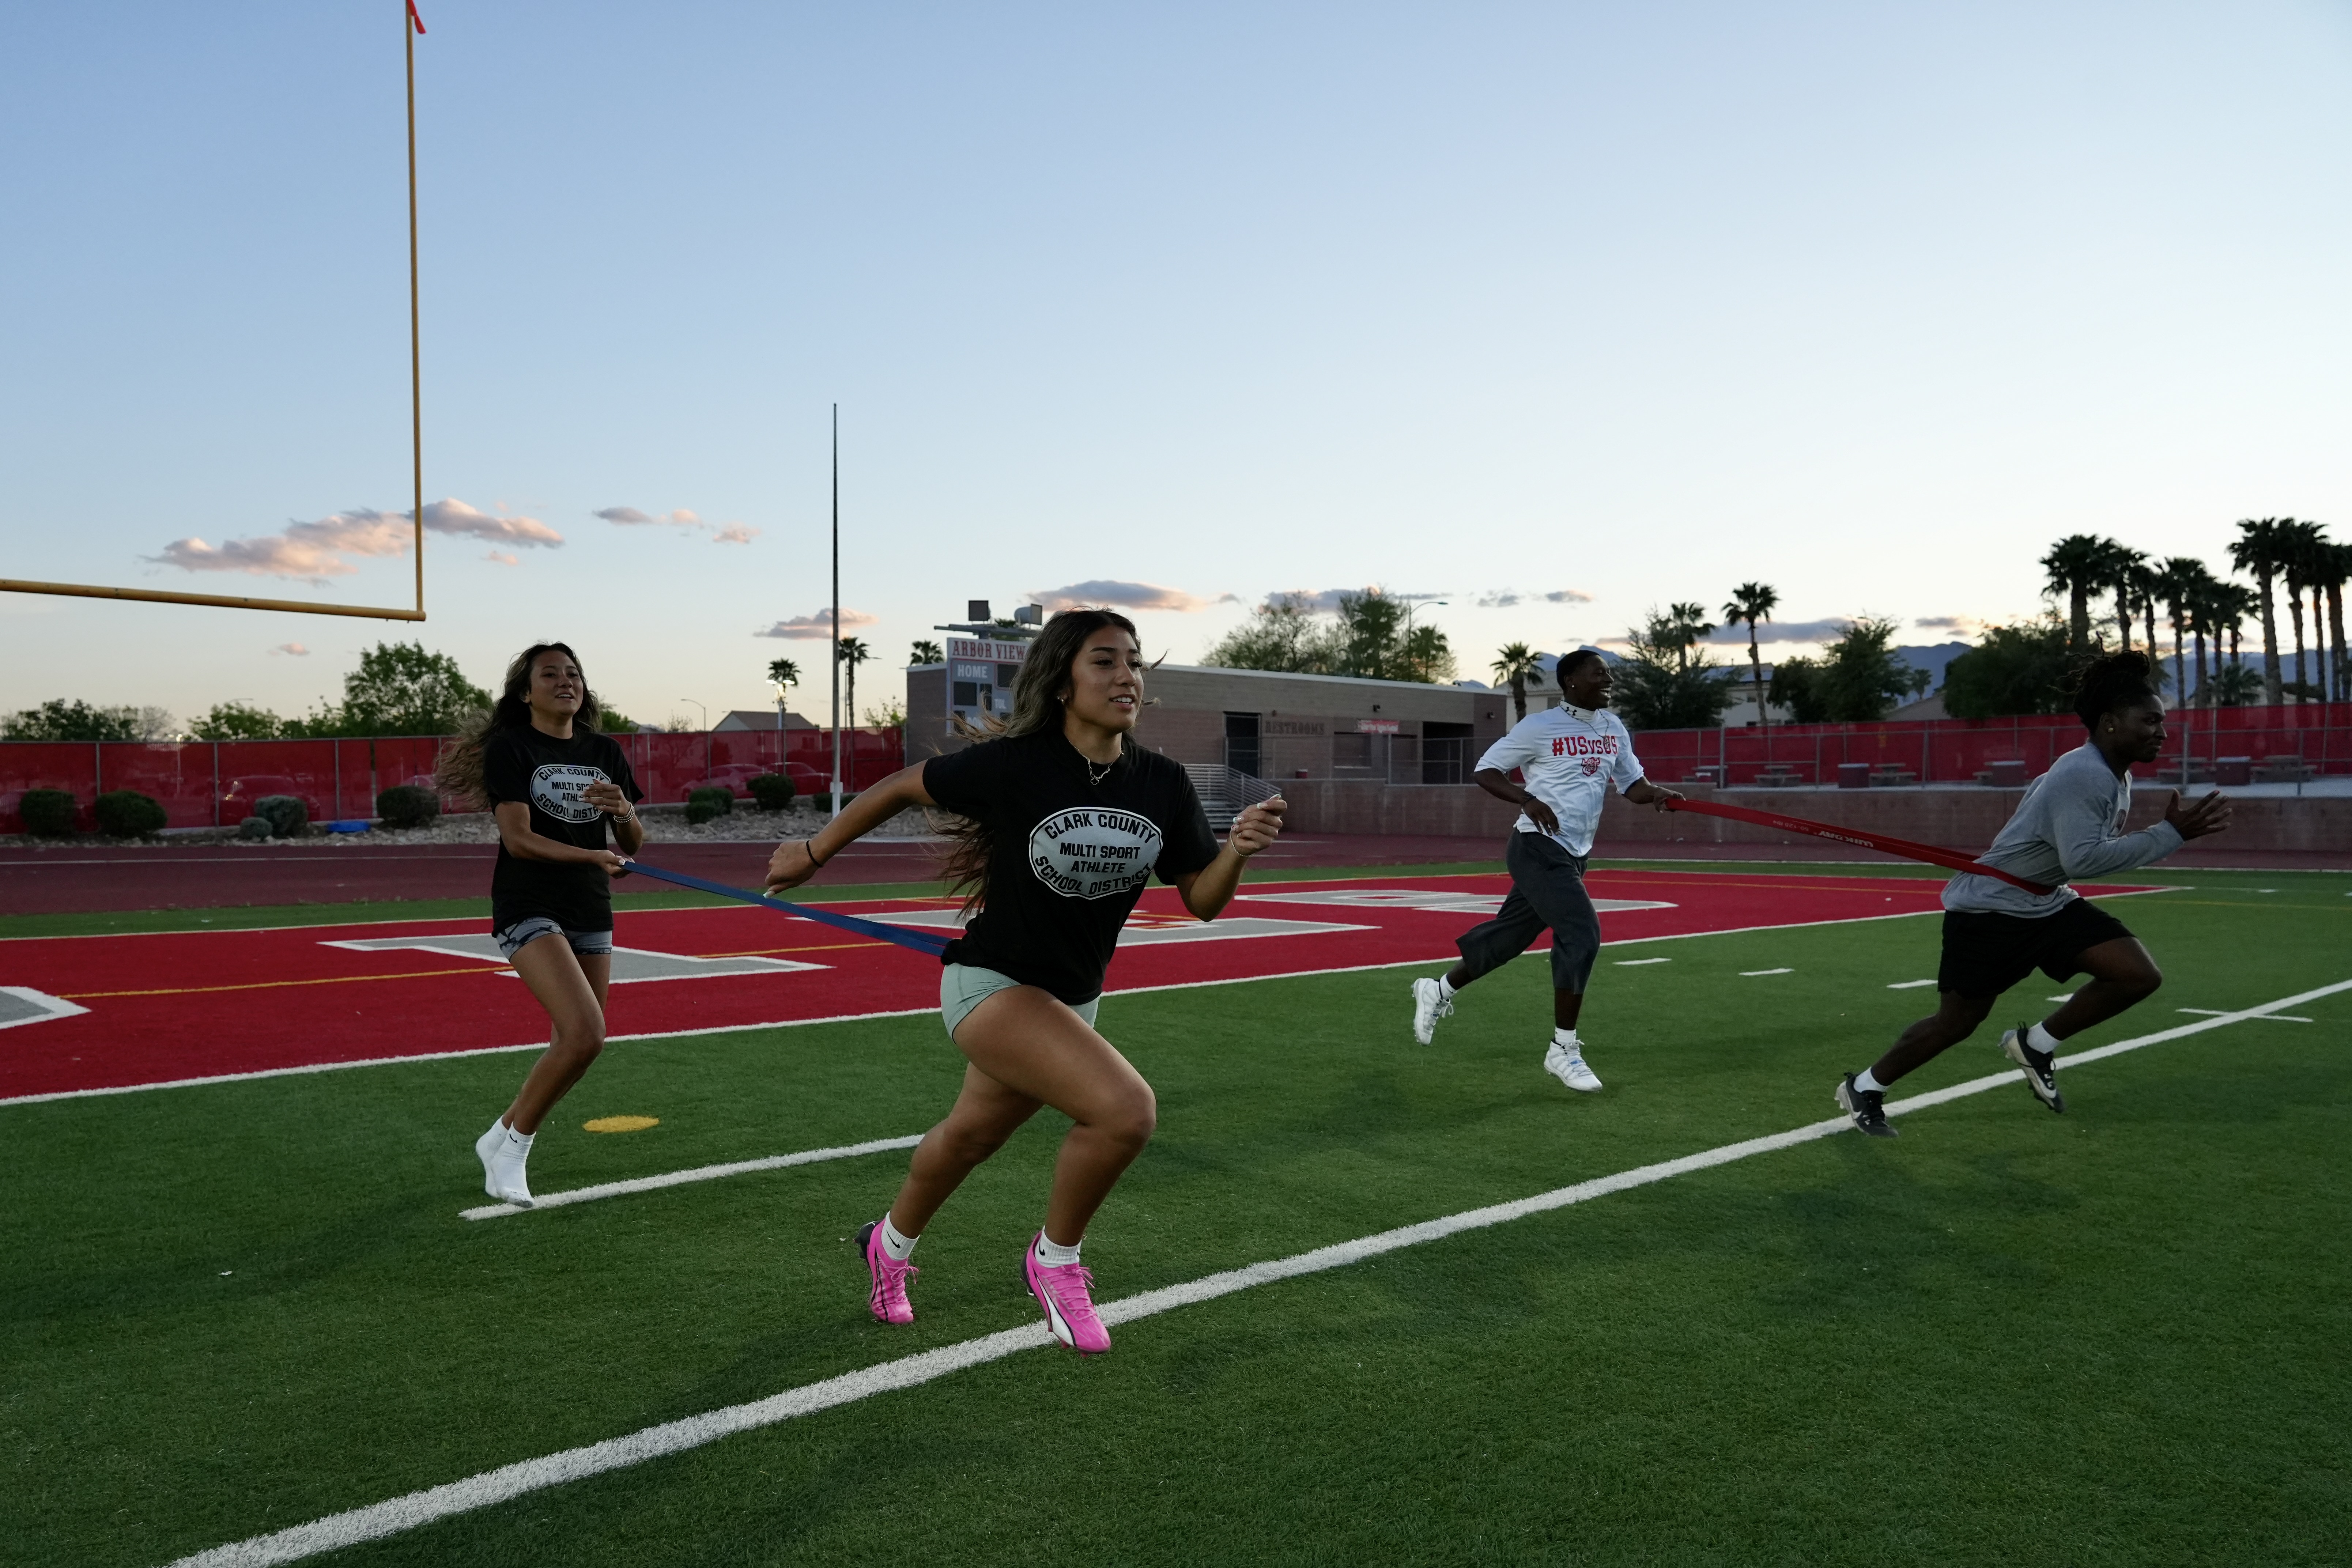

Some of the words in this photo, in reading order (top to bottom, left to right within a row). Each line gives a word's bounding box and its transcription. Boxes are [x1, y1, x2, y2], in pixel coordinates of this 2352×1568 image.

[952, 641, 992, 658] ARBOR
[996, 644, 1026, 660] VIEW
[957, 664, 988, 679] HOME
[1265, 721, 1325, 735] RESTROOMS
[539, 768, 566, 781] CLARK
[567, 768, 605, 781] COUNTY
[551, 781, 574, 791] MULTI
[537, 793, 569, 818] SCHOOL
[573, 806, 599, 819] DISTR
[1044, 813, 1093, 839] CLARK
[1098, 814, 1156, 844] COUNTY
[1060, 842, 1096, 858] MULTI
[1100, 846, 1141, 859] SPORT
[1071, 860, 1126, 873] ATHLETE
[1035, 855, 1083, 892] SCHOOL
[1088, 863, 1152, 895] DISTRICT
